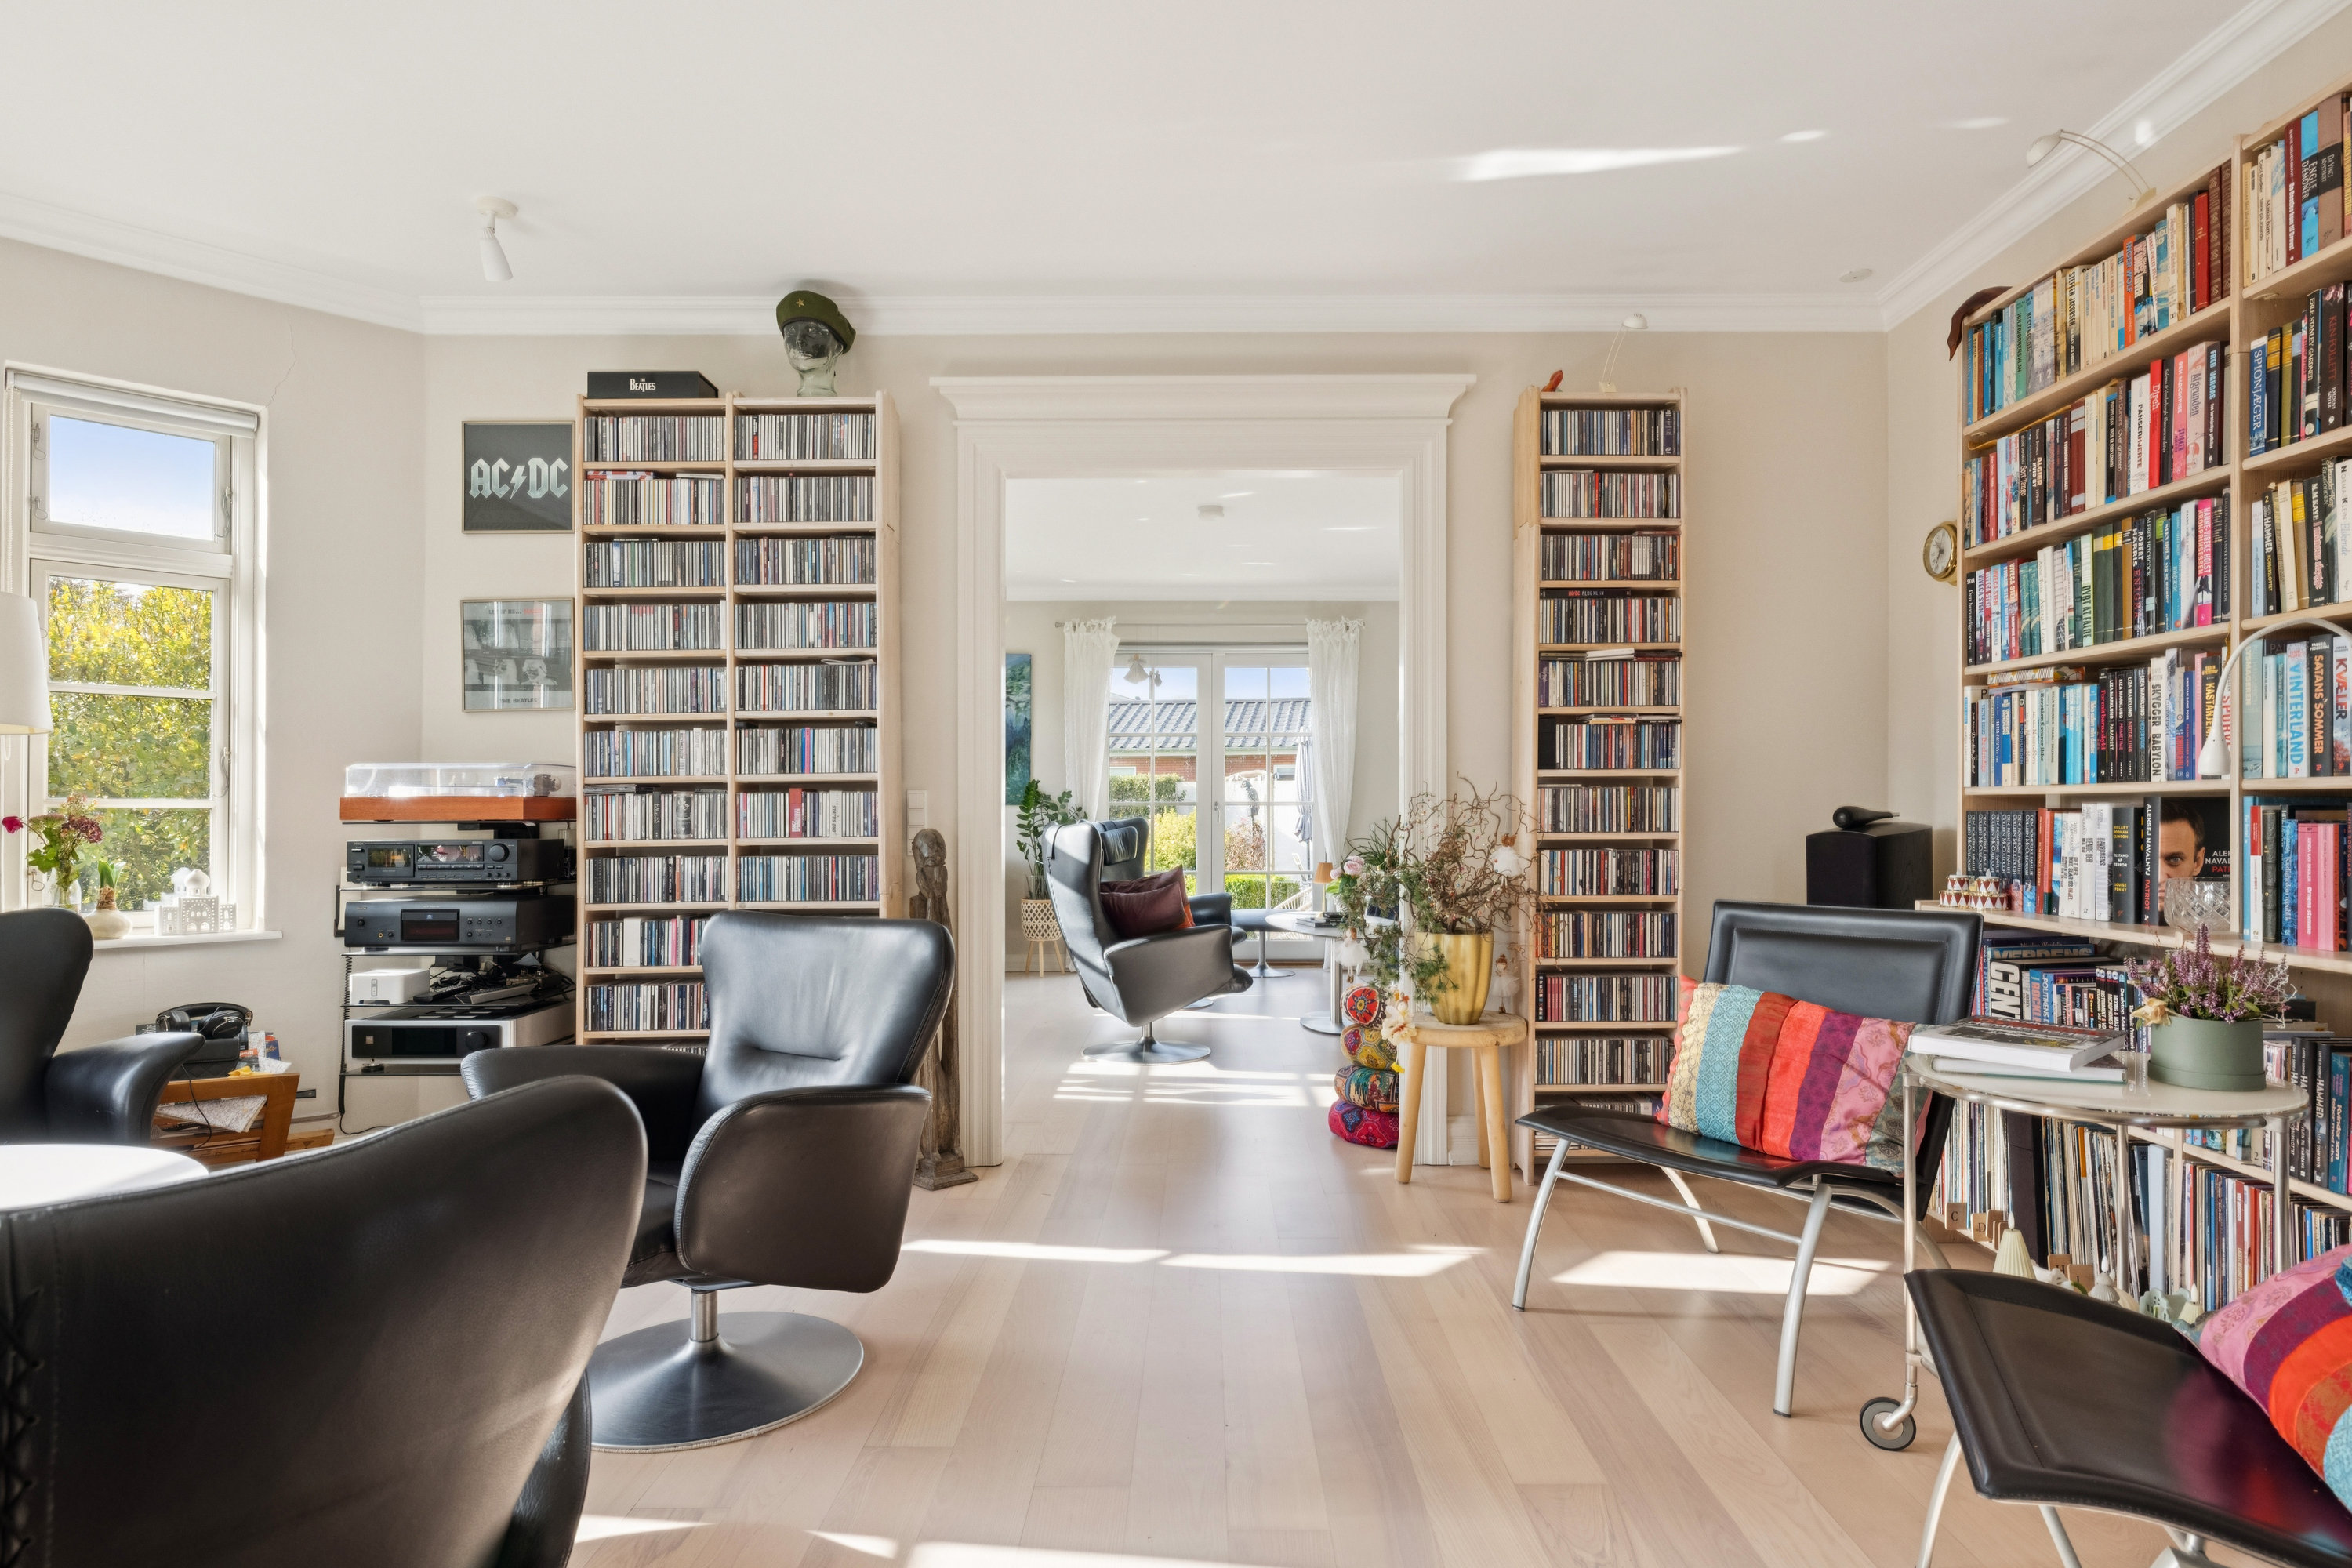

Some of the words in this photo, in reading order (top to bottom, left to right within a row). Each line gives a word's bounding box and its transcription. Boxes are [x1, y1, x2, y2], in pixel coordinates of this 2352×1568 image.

[2302, 161, 2310, 201] DÆMONER
[2309, 161, 2318, 191] ENGLE
[2328, 315, 2337, 337] KEN
[2328, 339, 2337, 379] FOLLETT
[630, 379, 656, 392] BEATLES
[2190, 372, 2202, 416] Afgrunden
[2252, 350, 2263, 430] SPIONJÆGER
[2032, 479, 2037, 488] BY
[2264, 517, 2273, 554] HAMMER
[2341, 523, 2350, 557] Elskende
[2082, 585, 2091, 605] DYRT
[2082, 607, 2091, 615] AT
[2314, 655, 2324, 699] SATANS
[2336, 658, 2347, 720] KVÆLER
[2152, 684, 2161, 727] SKYGGER
[2289, 663, 2304, 764] VINTERLAND
[2314, 703, 2324, 753] SOMMER
[2152, 733, 2161, 776] BABYLON
[2176, 735, 2184, 770] CHURCHILL
[1994, 947, 2092, 959] VERDENS
[2316, 1080, 2325, 1118] HAMMER
[1951, 1210, 1959, 1221] C
[1979, 1222, 1987, 1232] D
